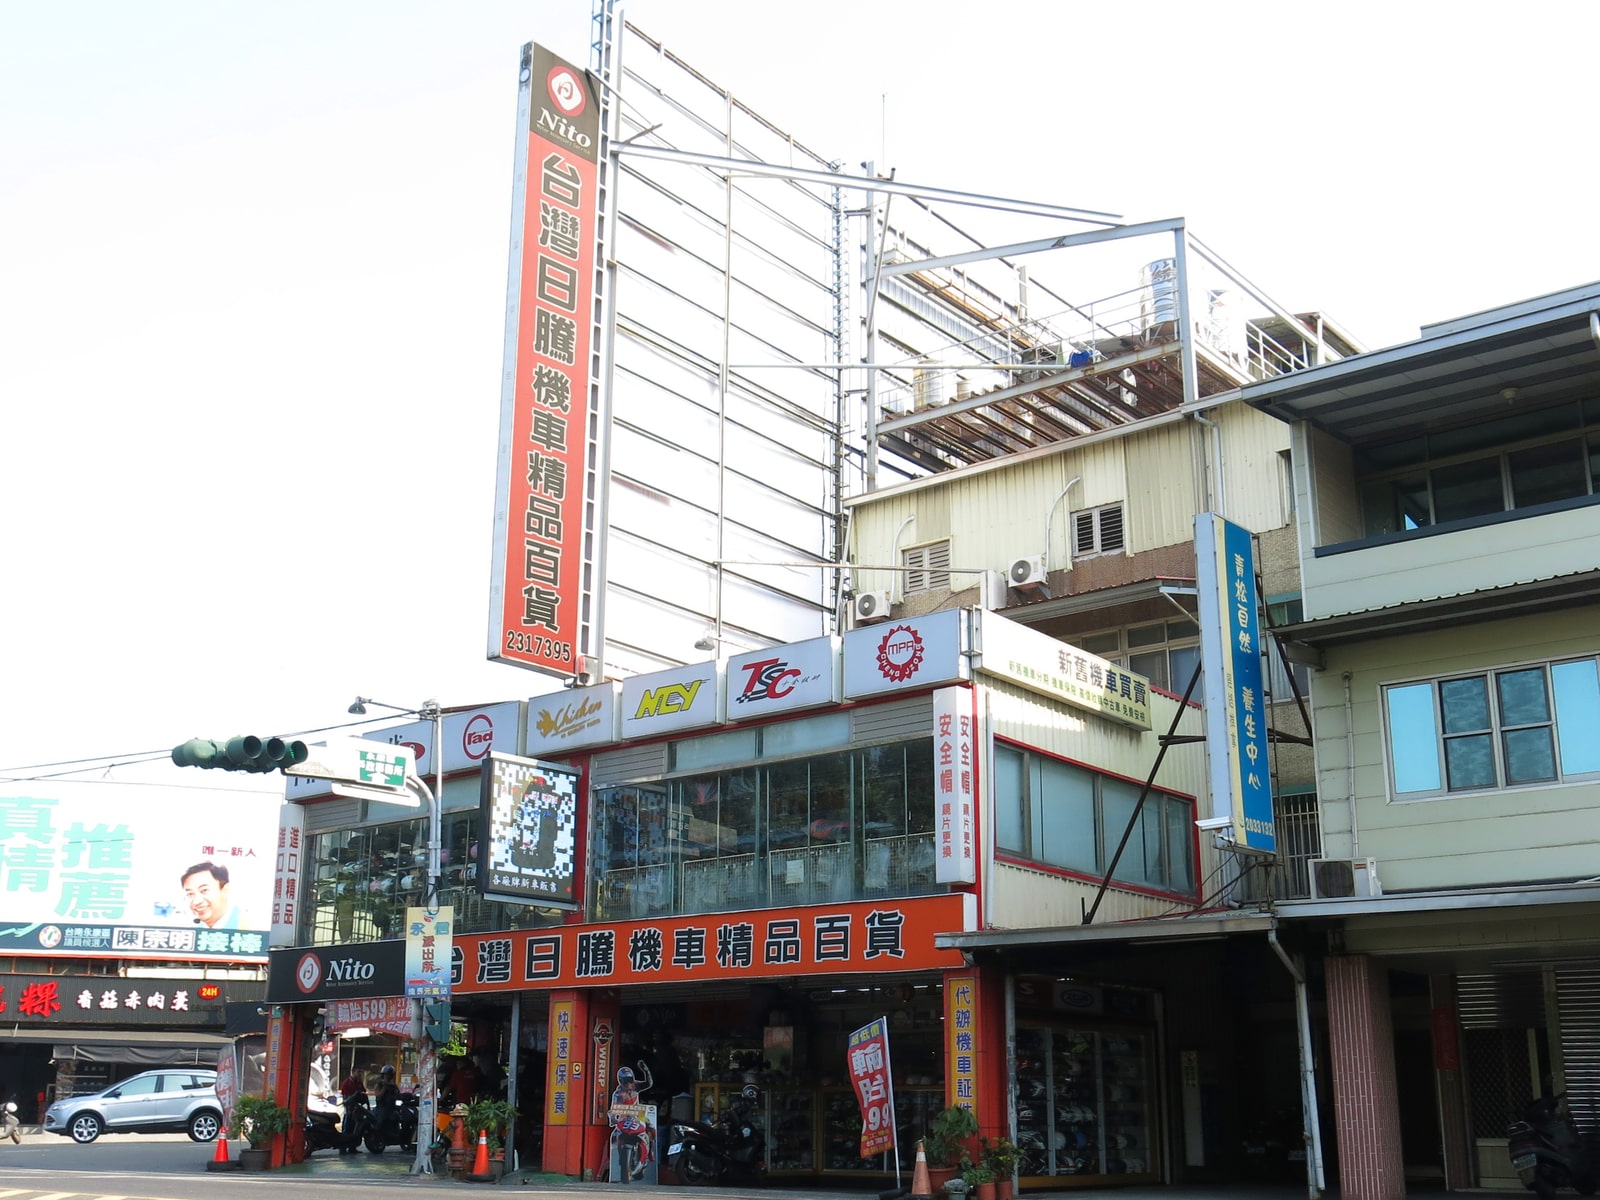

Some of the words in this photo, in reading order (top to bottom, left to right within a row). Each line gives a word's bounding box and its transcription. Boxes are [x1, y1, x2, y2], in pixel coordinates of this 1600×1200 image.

[536, 105, 592, 149] Nito
[521, 151, 582, 632] 台灣日騰機車精品百貨
[505, 630, 572, 663] 2317395
[888, 640, 914, 656] MPA
[738, 657, 802, 704] TSC
[1058, 648, 1147, 708] 新舊機車買賣
[634, 679, 704, 720] NCY
[939, 713, 953, 795] 安全帽
[960, 714, 971, 795] 安全帽
[54, 822, 134, 920] 推薦
[201, 845, 256, 858] 唯一新人
[197, 931, 263, 954] 接棒
[326, 957, 375, 981] Nito
[77, 989, 189, 1012] 香菇赤肉羹
[201, 987, 218, 997] 24H
[553, 1011, 569, 1114] 快速保養
[851, 1041, 887, 1108] 輪胎
[622, 1121, 641, 1131] 93
[862, 1103, 890, 1134] 99
